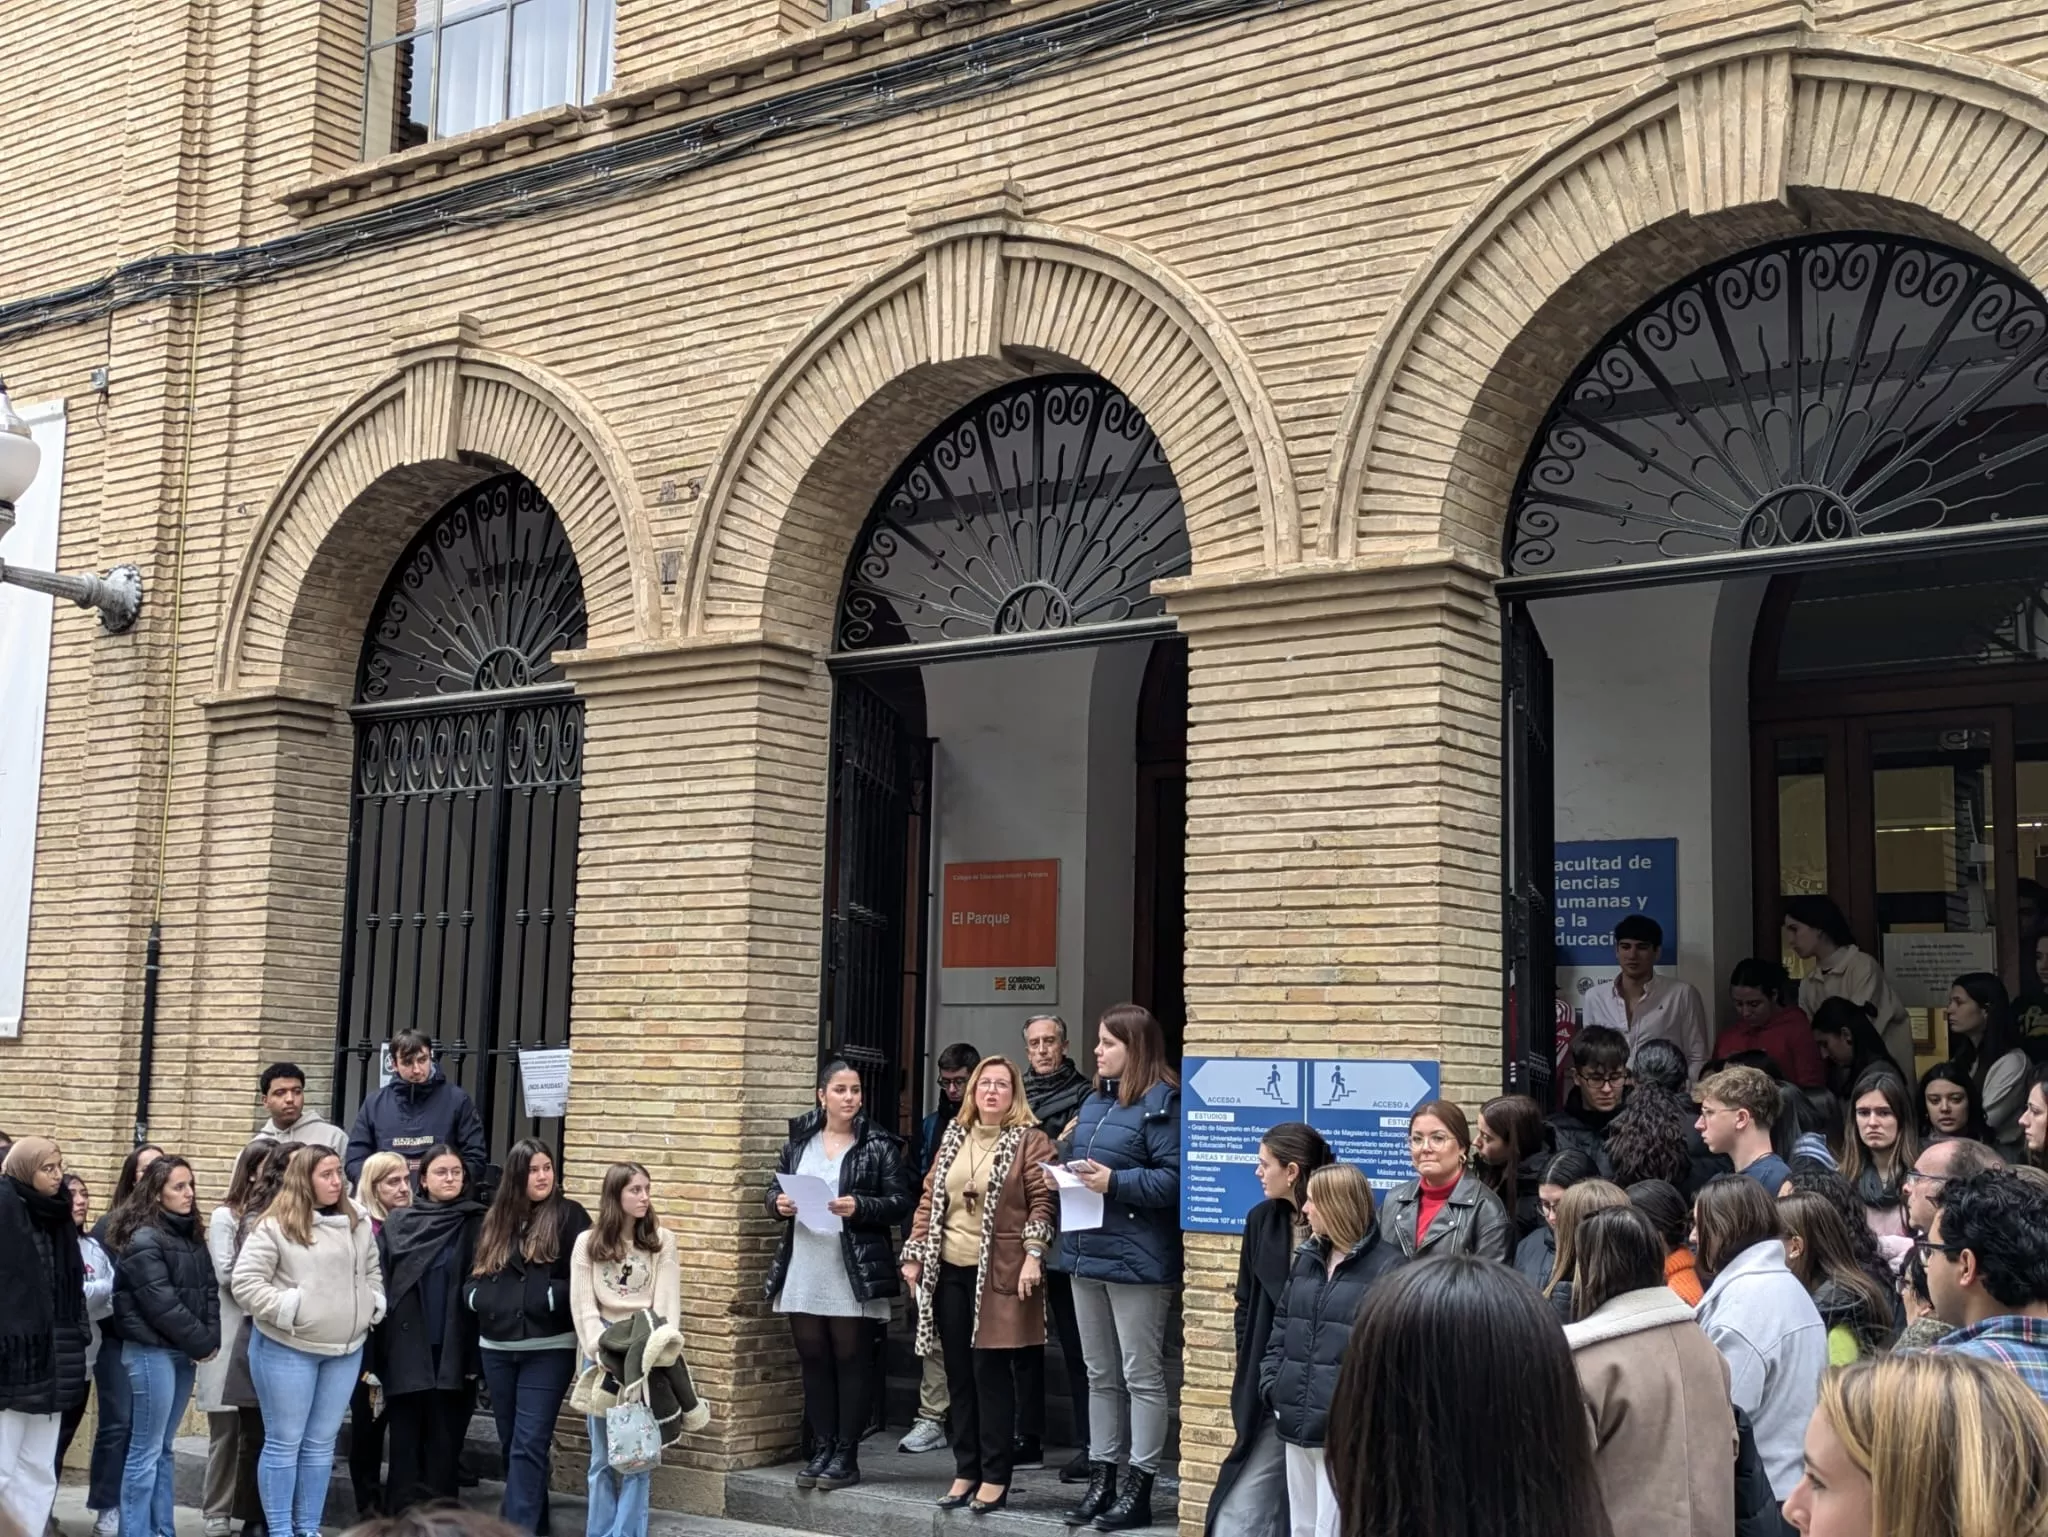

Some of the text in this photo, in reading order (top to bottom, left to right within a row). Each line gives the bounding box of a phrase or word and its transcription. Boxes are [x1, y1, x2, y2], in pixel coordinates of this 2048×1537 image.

[1554, 854, 1652, 871] acultad de
[1555, 875, 1620, 890] iencias
[1556, 896, 1648, 911] umanas y
[952, 912, 1010, 927] El Parque
[1555, 913, 1588, 927] e la
[1555, 931, 1615, 946] ducaci
[1207, 1096, 1235, 1104] ACCESO
[1372, 1101, 1402, 1109] ACCESO
[1195, 1112, 1228, 1120] ESTUDIOS
[1387, 1118, 1411, 1126] ESTUD
[1216, 1125, 1242, 1133] Magisterio
[1342, 1129, 1370, 1137] Magisterio
[1199, 1141, 1226, 1149] Educación
[1345, 1147, 1382, 1155] Comunicación
[1378, 1158, 1398, 1167] Lengua
